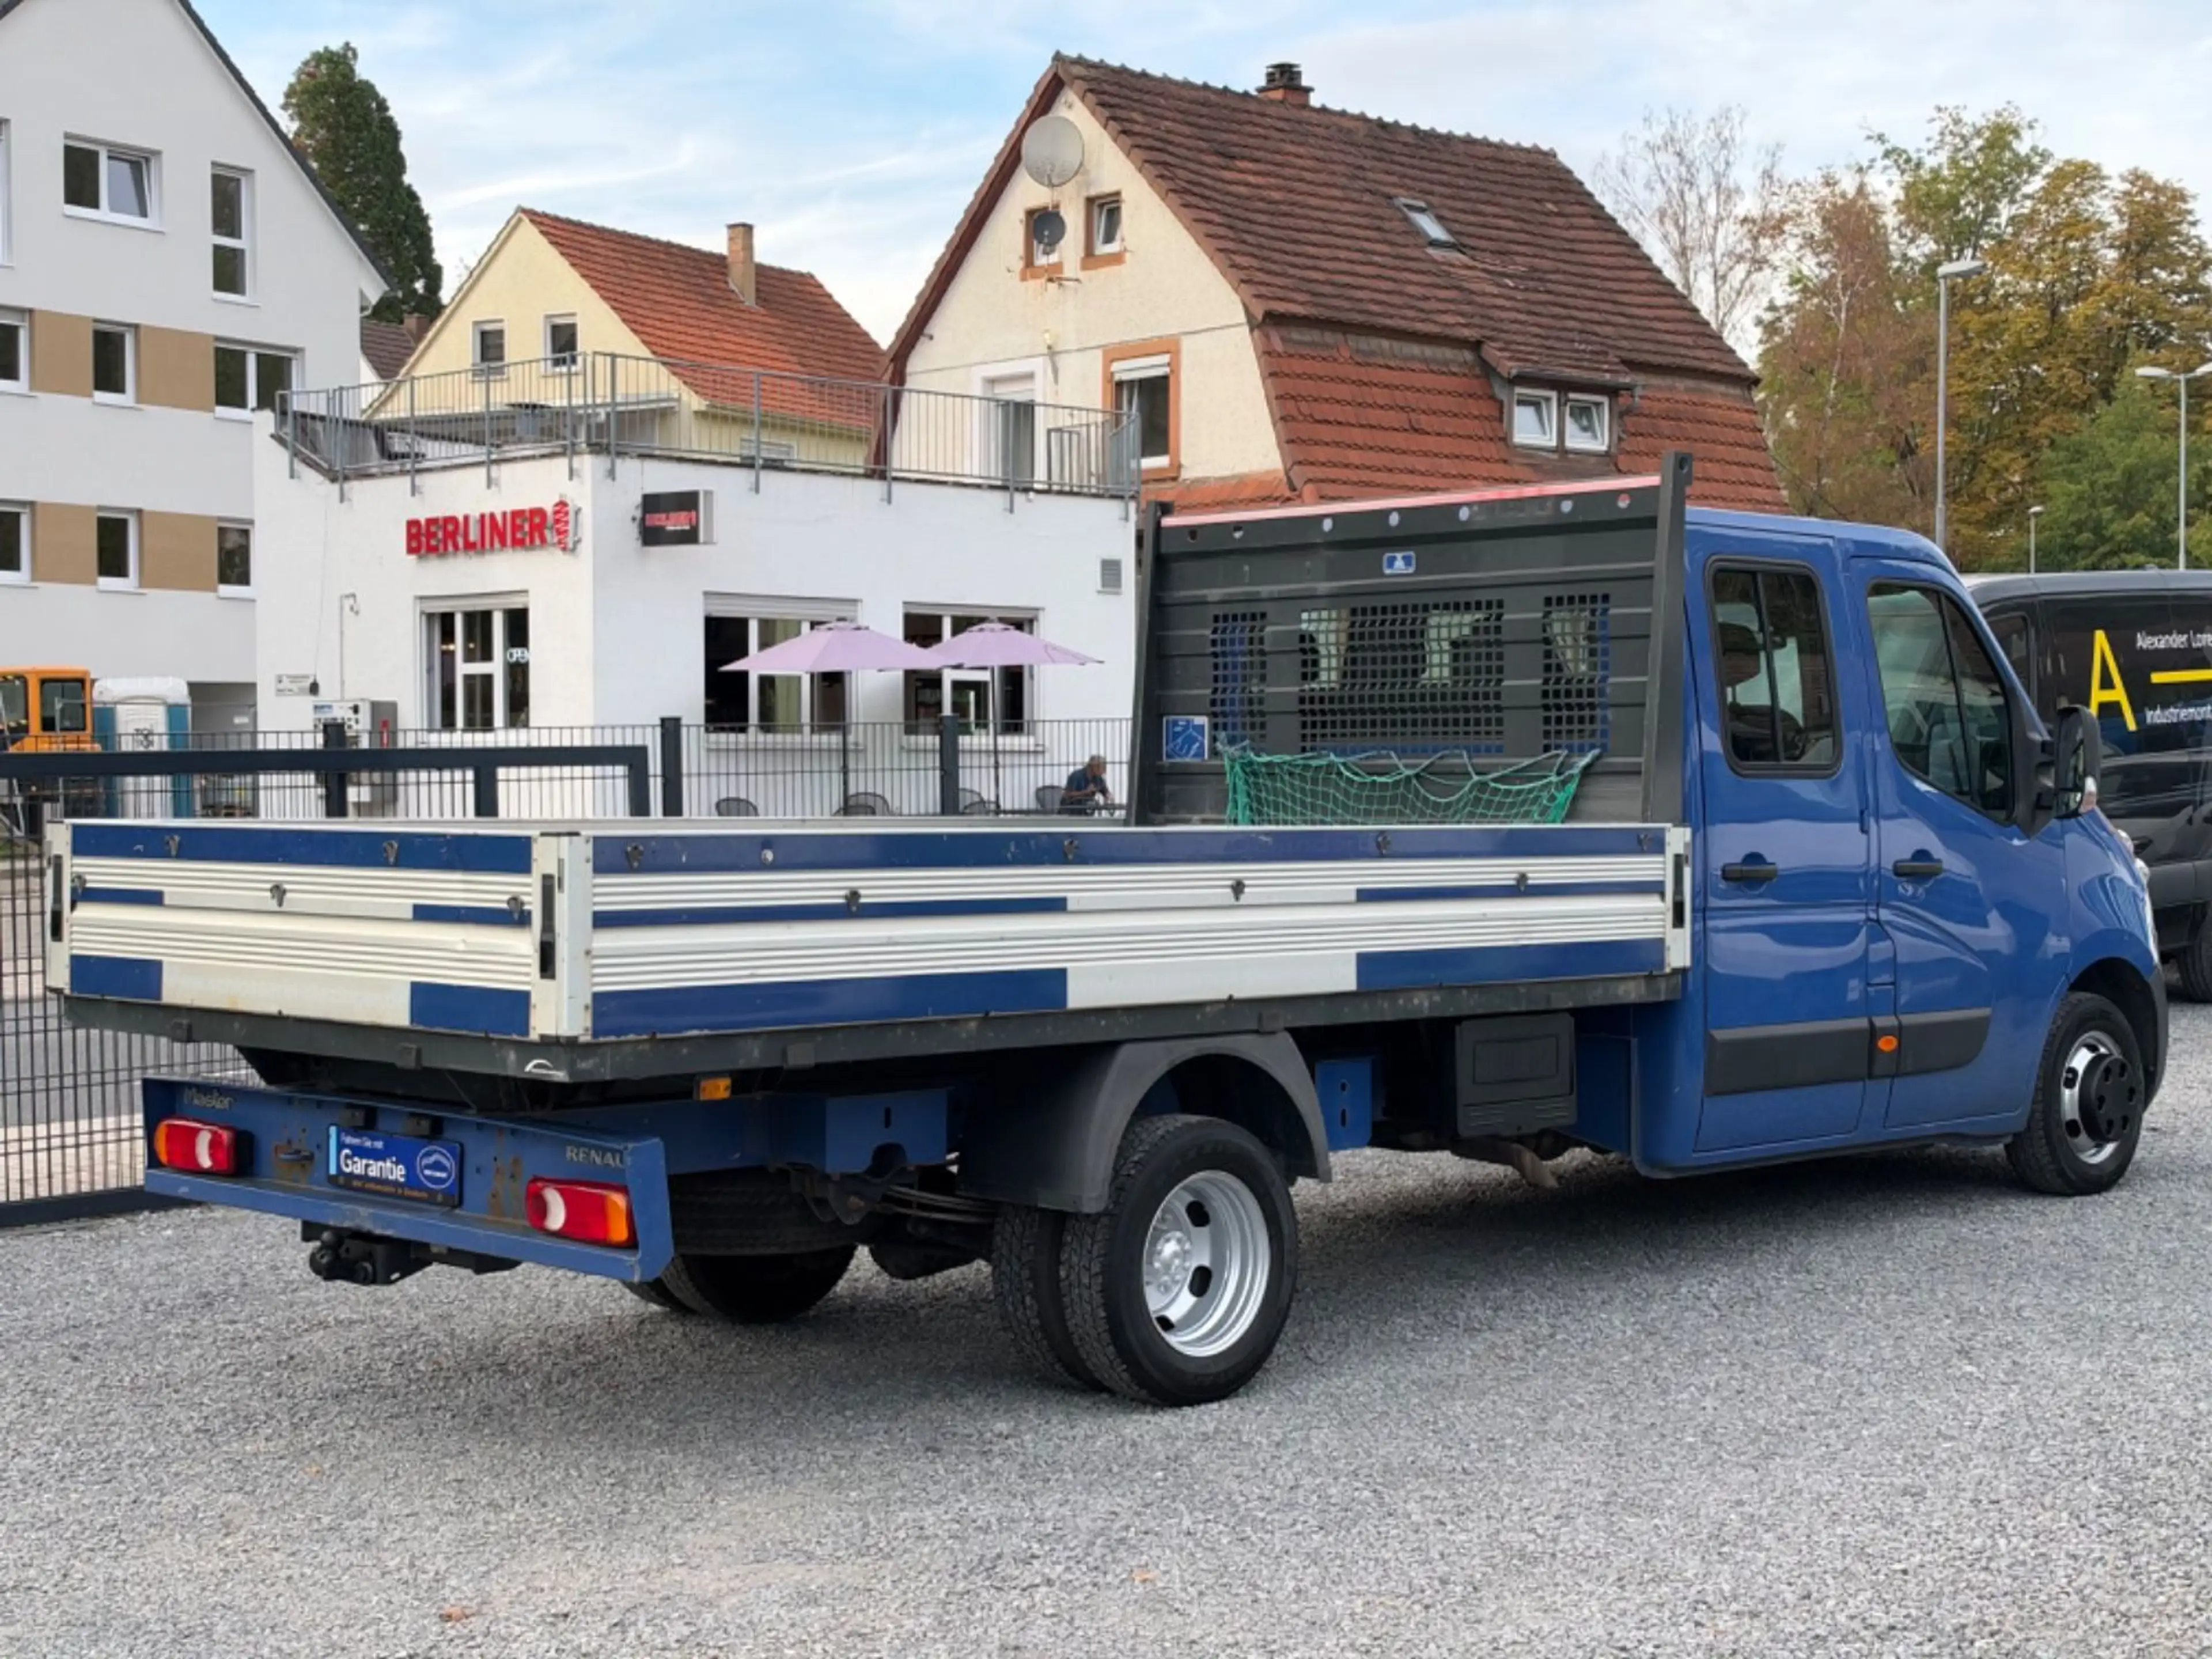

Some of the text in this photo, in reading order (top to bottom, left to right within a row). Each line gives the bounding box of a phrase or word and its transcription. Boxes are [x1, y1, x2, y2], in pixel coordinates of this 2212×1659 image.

[406, 507, 547, 554] BERLINER
[2136, 629, 2188, 650] Alexander
[2089, 629, 2138, 732] A
[184, 1086, 233, 1112] Master
[340, 1148, 406, 1182] Garantie
